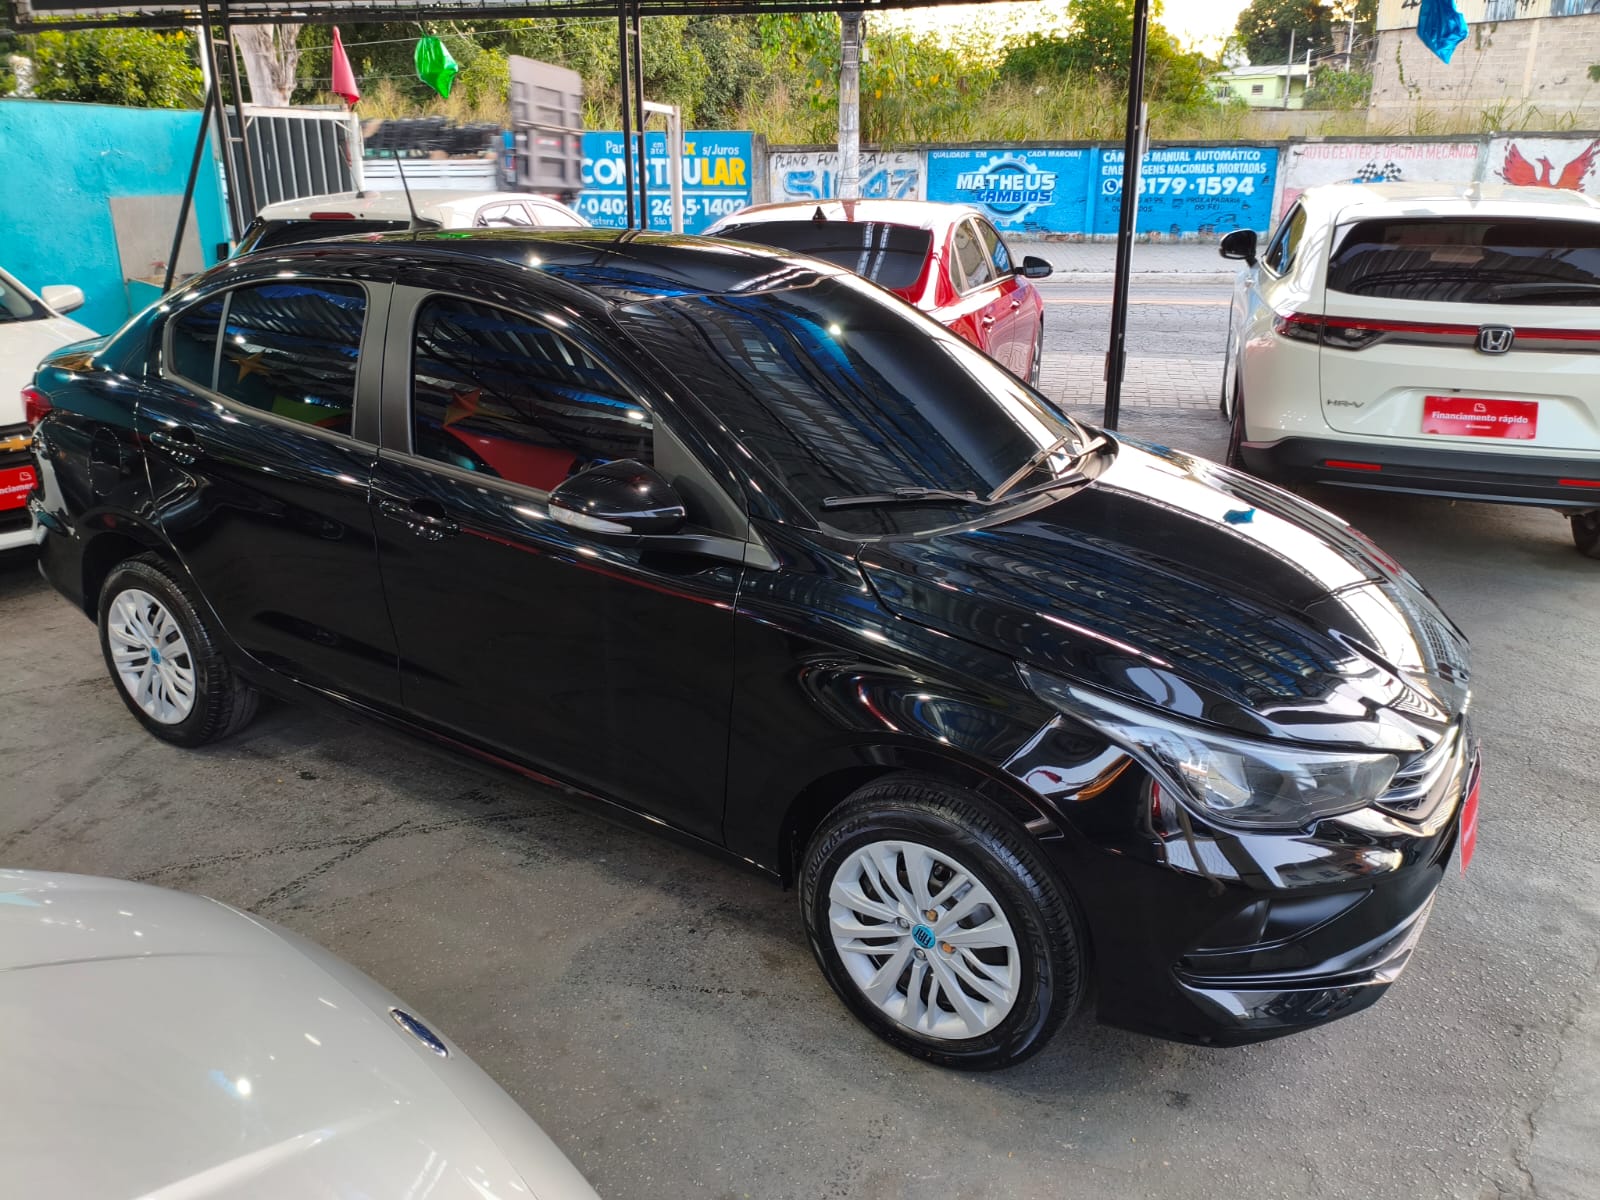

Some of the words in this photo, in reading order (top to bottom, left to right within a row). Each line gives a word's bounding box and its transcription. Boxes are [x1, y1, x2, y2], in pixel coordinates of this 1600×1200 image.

[606, 140, 643, 155] Parel
[703, 145, 740, 155] s/Juros
[1303, 147, 1329, 160] AUTO
[1333, 146, 1375, 160] CENTER
[775, 154, 809, 169] PLANO
[932, 151, 970, 159] QUALIDADE
[1151, 152, 1191, 162] MANUAL
[1194, 149, 1261, 161] AUTOMÁTICO
[581, 157, 746, 186] CONSTULAR
[1167, 163, 1214, 174] NACIONAIS
[956, 173, 1056, 191] MATHEUS
[976, 190, 1052, 202] CAMBIOS
[1432, 411, 1497, 423] Financiamento
[1498, 416, 1529, 425] rápido
[913, 927, 932, 947] FIAT
